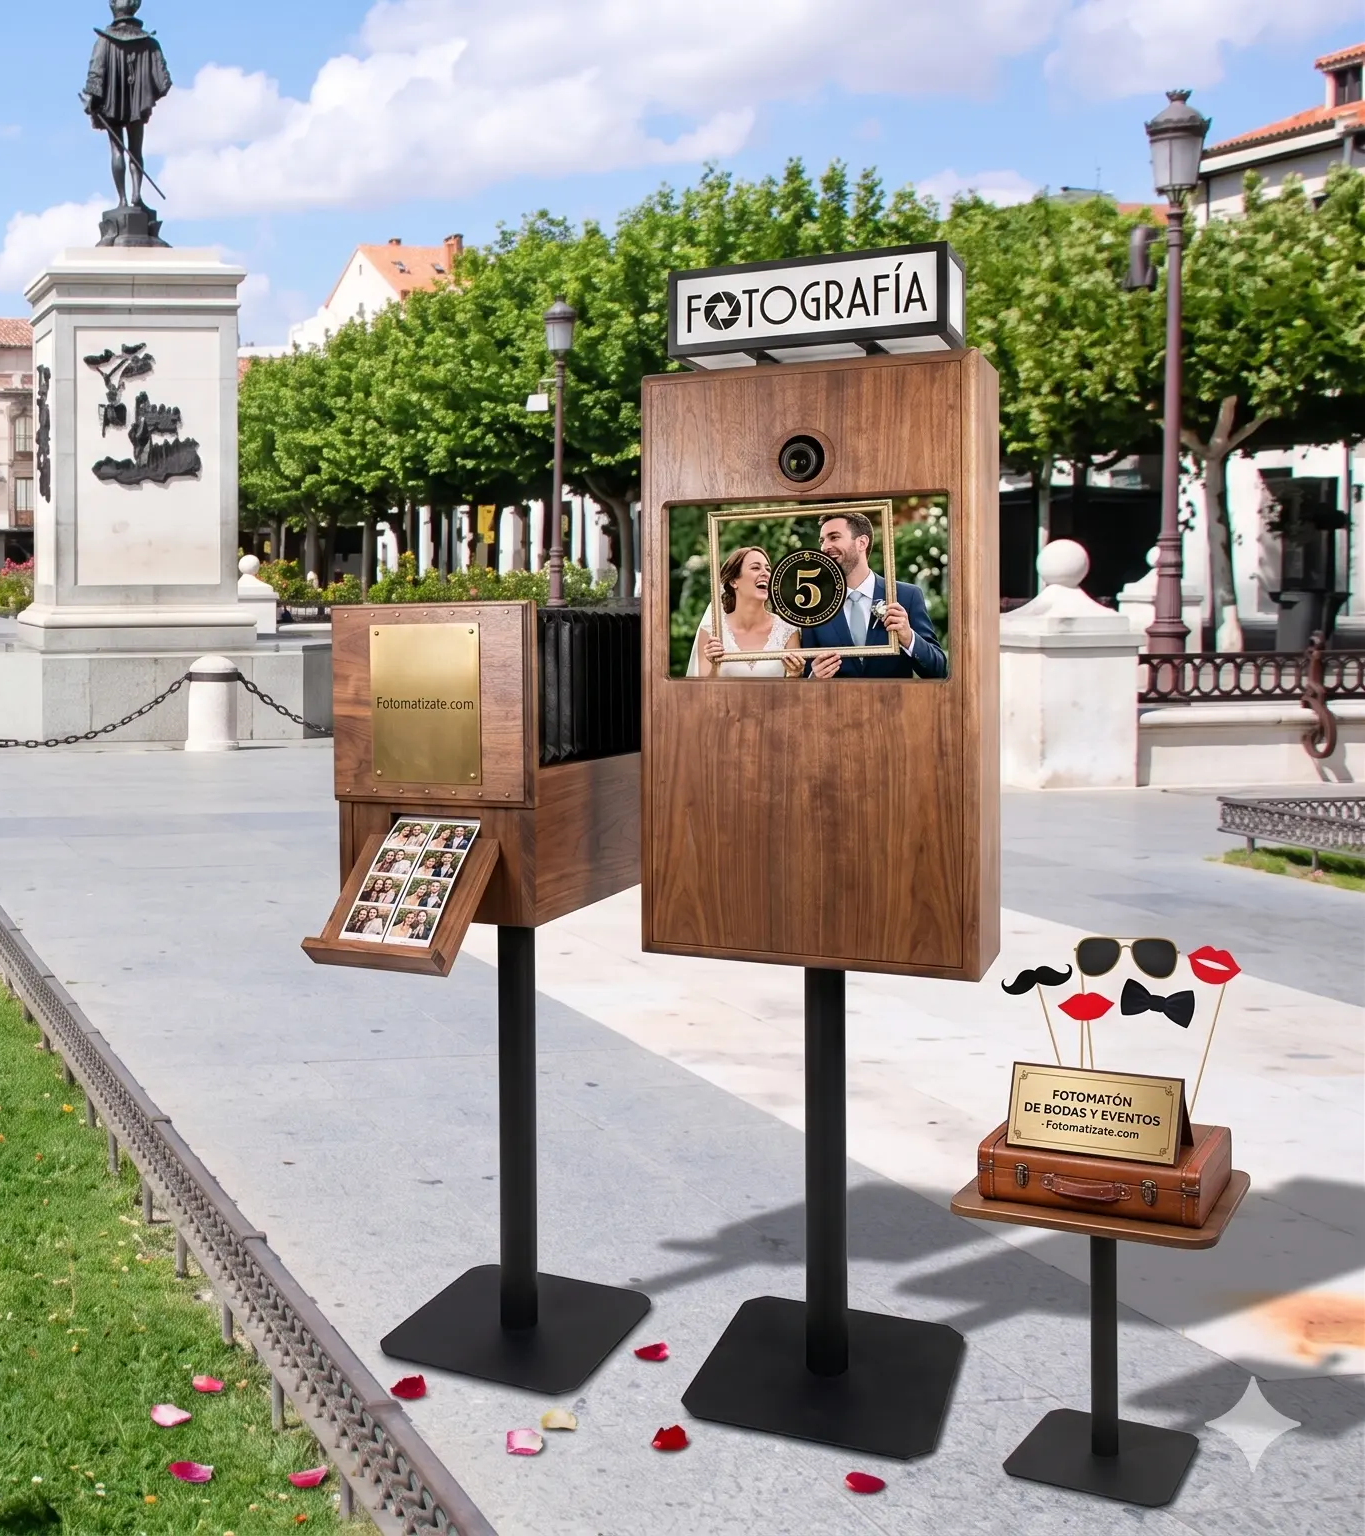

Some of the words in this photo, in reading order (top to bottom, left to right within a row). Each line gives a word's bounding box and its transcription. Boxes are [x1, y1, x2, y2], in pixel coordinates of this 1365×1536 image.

[795, 567, 822, 609] 5
[376, 696, 474, 711] Fotomatizate.com
[1052, 1089, 1133, 1108] FOTOMATÓN
[1024, 1102, 1041, 1113] DE
[1044, 1105, 1086, 1119] BODAS
[1090, 1109, 1099, 1119] Y
[1101, 1111, 1161, 1127] EVENTOS
